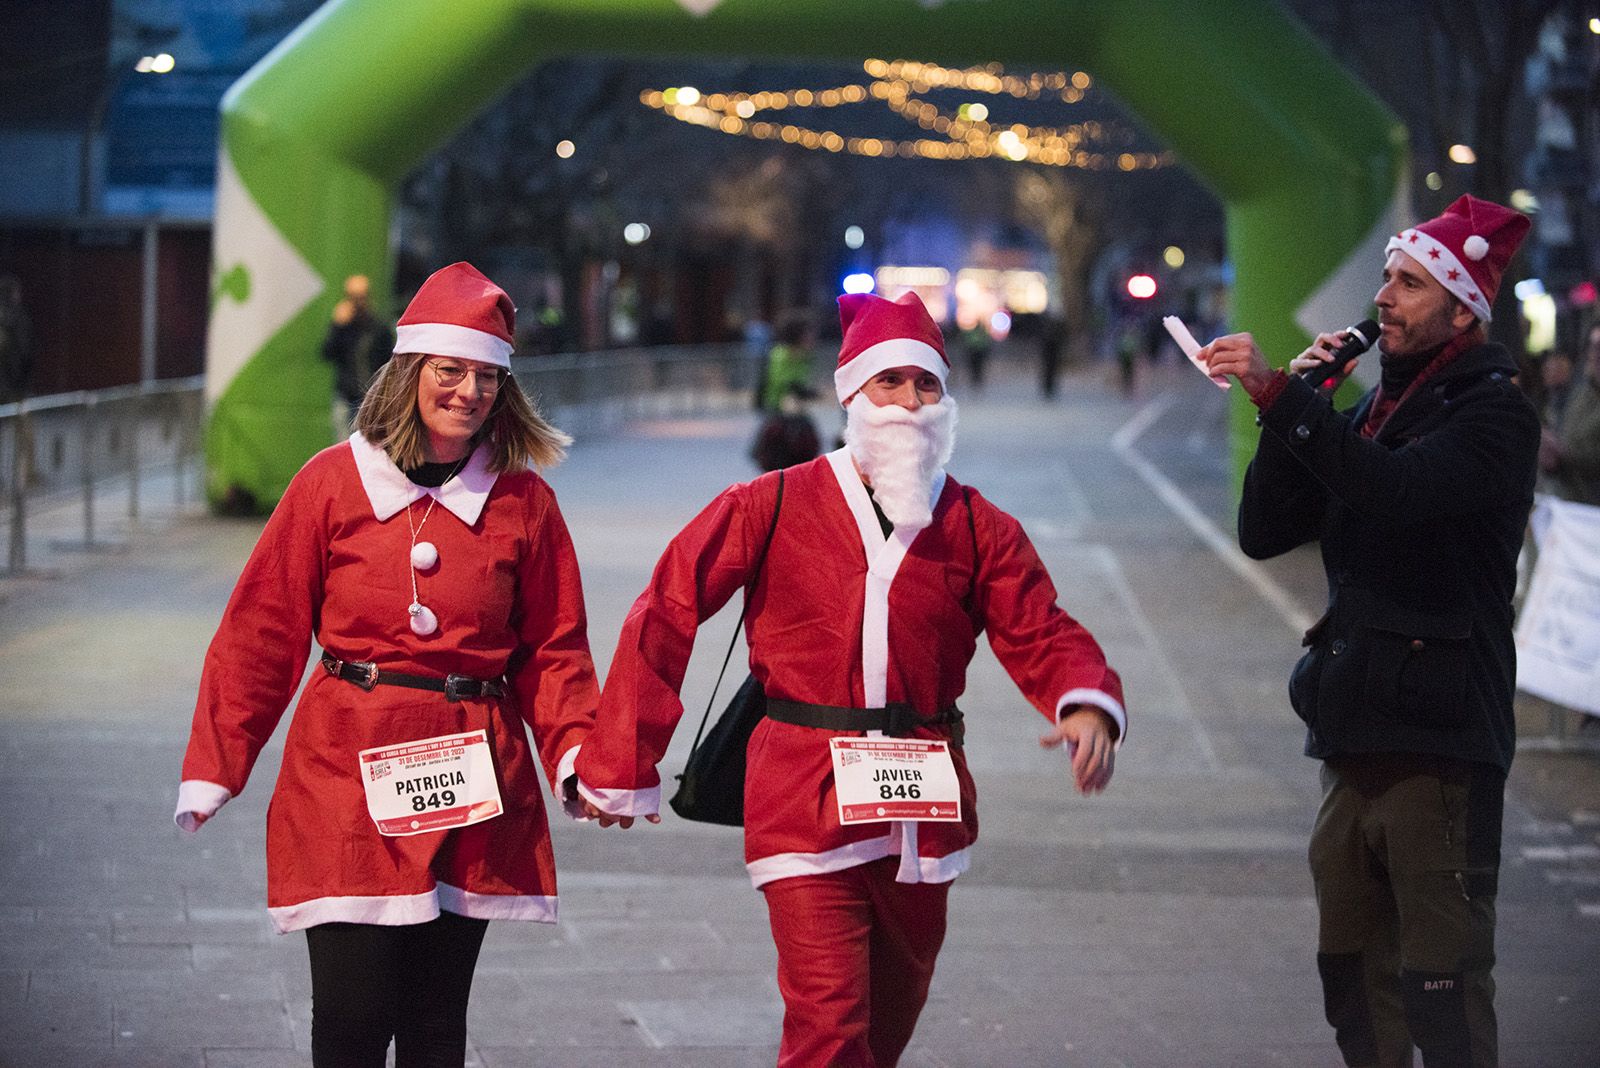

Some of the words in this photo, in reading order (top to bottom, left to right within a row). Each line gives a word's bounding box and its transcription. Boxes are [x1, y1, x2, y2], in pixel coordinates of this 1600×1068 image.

[398, 757, 405, 765] 31
[405, 756, 413, 764] DE
[413, 751, 442, 763] DESEMBRE
[442, 750, 450, 758] DE
[451, 747, 465, 757] 2023
[395, 770, 466, 796] PATRICIA
[873, 769, 922, 782] JAVIER
[879, 783, 921, 799] 846
[411, 789, 456, 812] 849
[1423, 980, 1454, 991] BATTI
